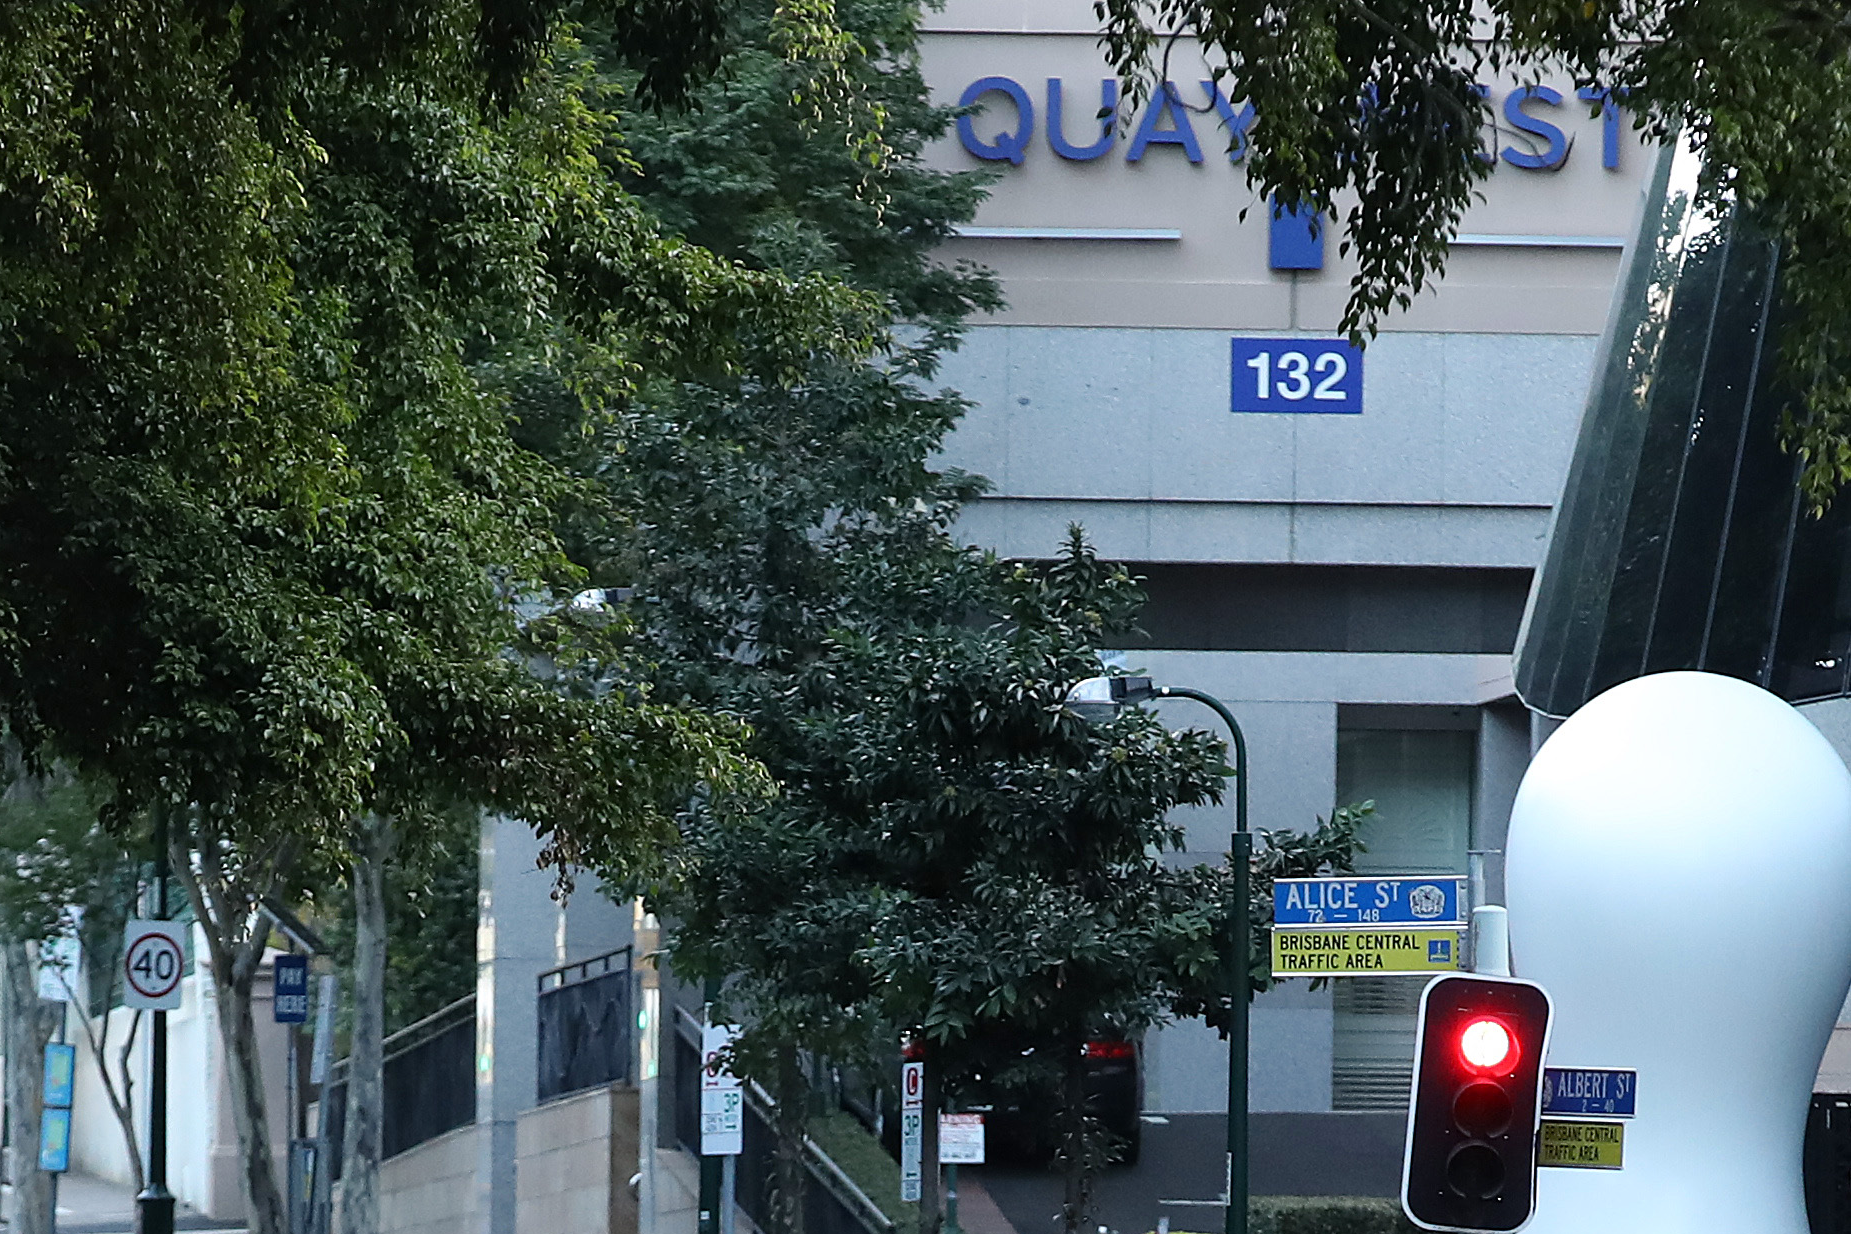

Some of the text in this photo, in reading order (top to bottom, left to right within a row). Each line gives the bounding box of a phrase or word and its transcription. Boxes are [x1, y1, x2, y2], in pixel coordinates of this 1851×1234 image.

[956, 75, 1271, 166] QUAY
[1247, 352, 1347, 400] 132
[1286, 882, 1400, 909] ALICE ST
[1307, 910, 1326, 922] 72
[1357, 909, 1380, 922] 148
[1280, 934, 1420, 950] BRISBANE CENTRAL
[133, 949, 173, 980] 40
[1280, 954, 1383, 969] TRAFFIC AREA
[279, 967, 303, 985] PAY
[276, 995, 306, 1013] HERE
[1558, 1072, 1631, 1099] ALBERT ST
[1582, 1099, 1587, 1112] 2
[1604, 1099, 1615, 1112] 40
[1544, 1125, 1619, 1143] BRISBANE CENTRAL
[1544, 1144, 1599, 1160] TRAFFIC AREA
